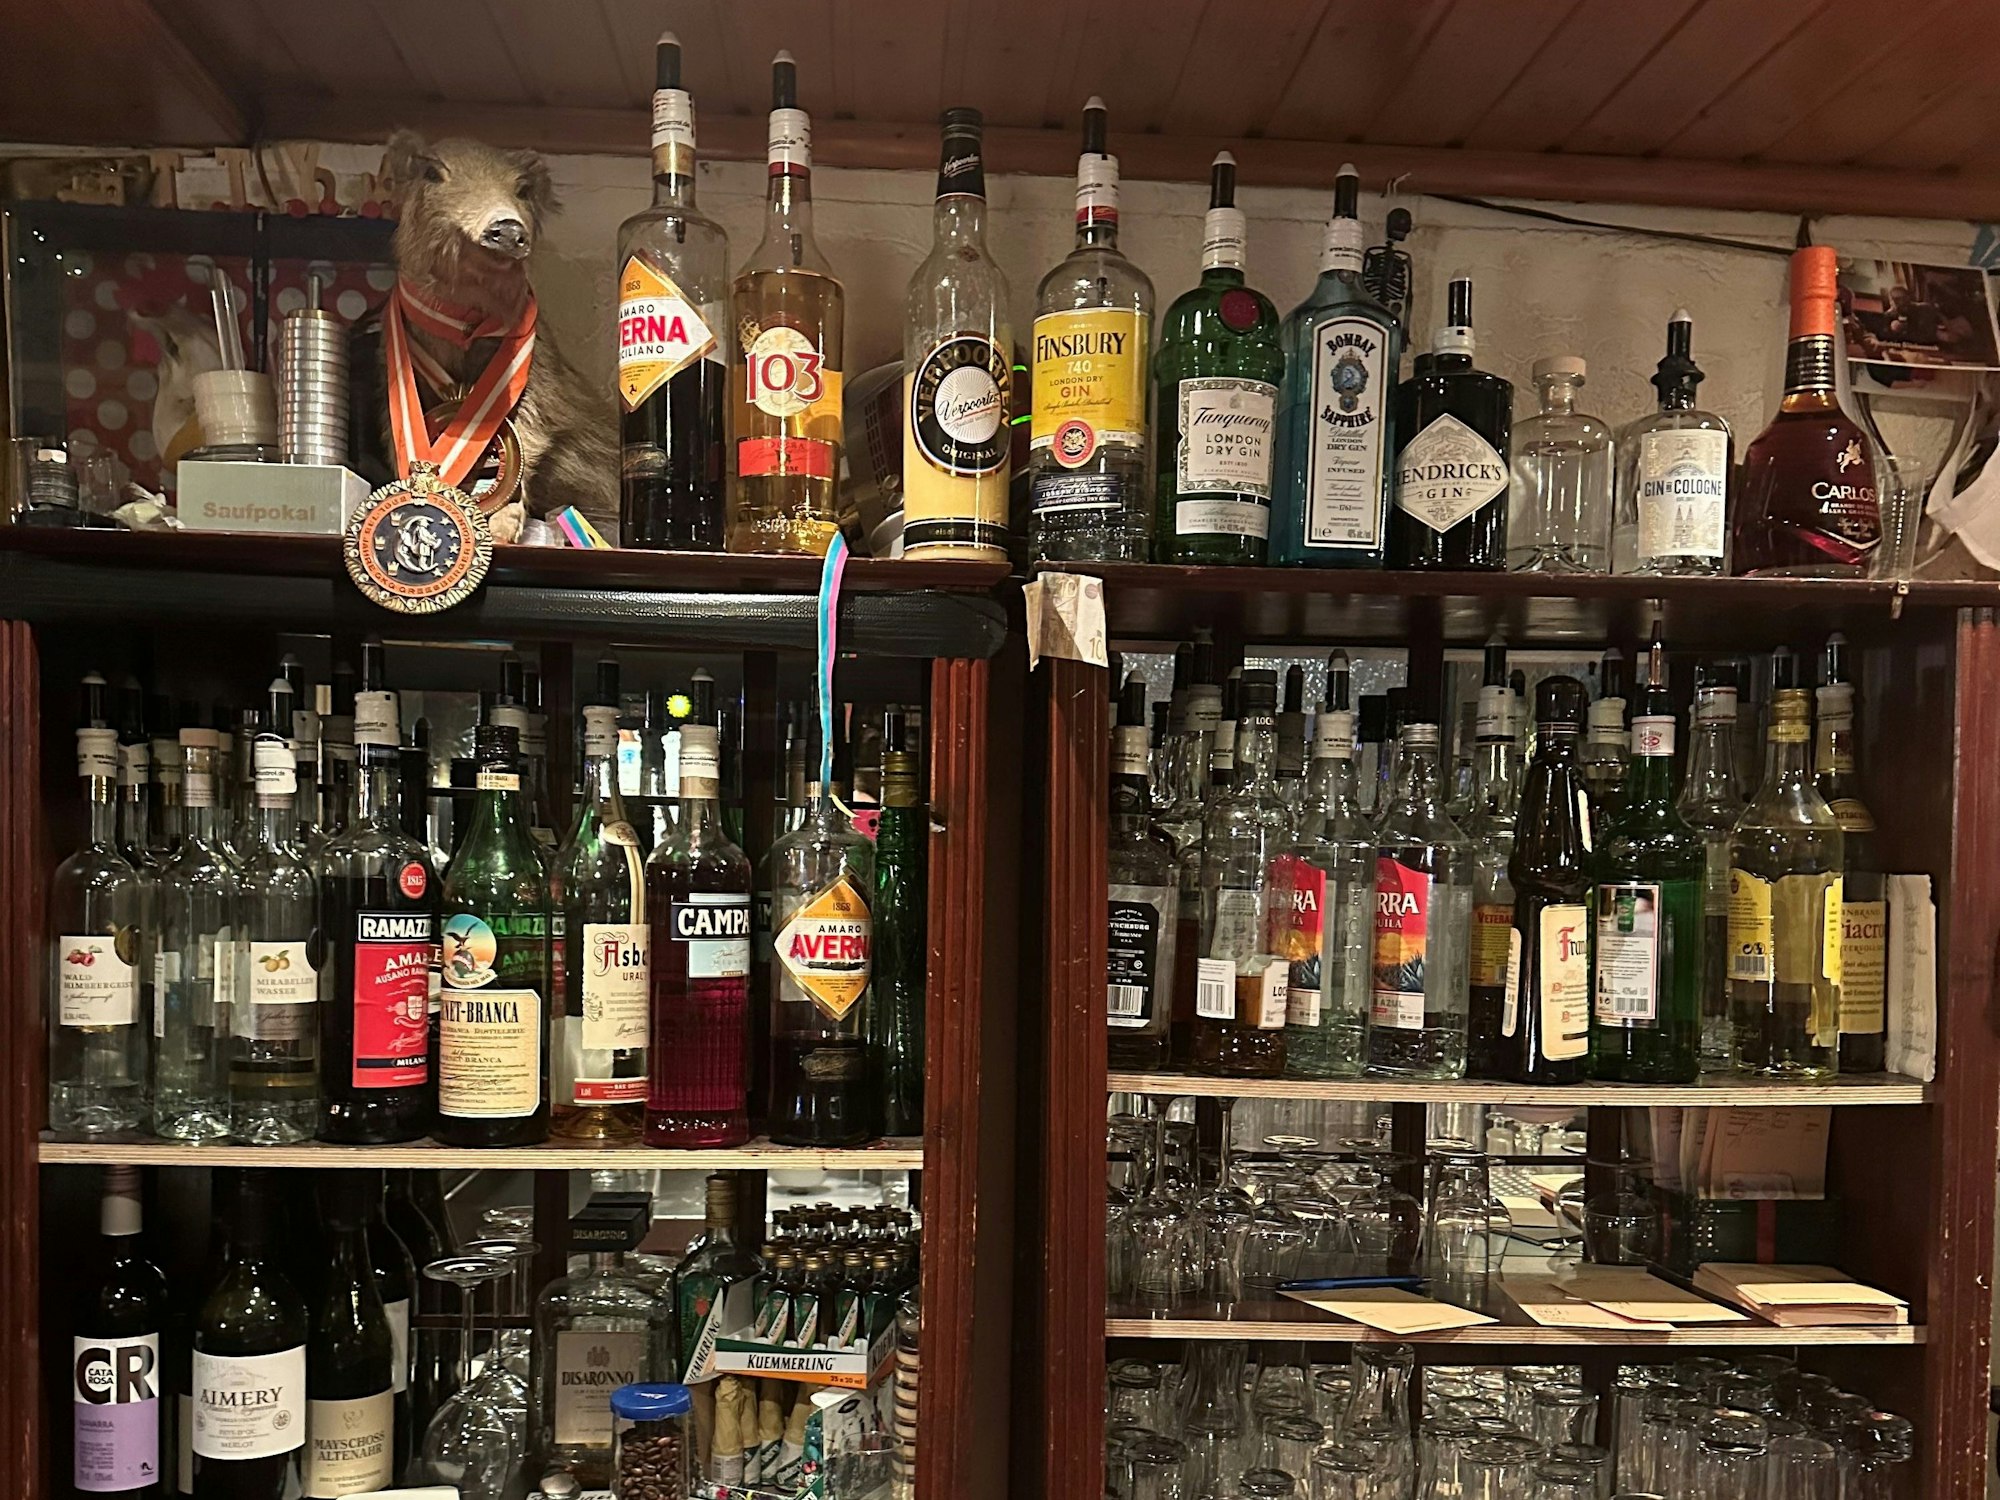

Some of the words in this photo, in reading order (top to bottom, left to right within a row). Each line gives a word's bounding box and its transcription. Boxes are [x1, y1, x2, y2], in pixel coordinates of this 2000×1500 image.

[620, 316, 689, 347] ERNA
[1036, 332, 1127, 364] FINSBURY
[1326, 333, 1376, 358] BOMBAY
[746, 351, 825, 404] 103
[918, 343, 1011, 429] VERPOORTEN
[1050, 377, 1083, 387] LONDON
[1086, 375, 1104, 383] DRY
[1060, 385, 1090, 398] GIN
[1193, 407, 1270, 433] Tanqueray
[1320, 405, 1377, 428] SAPPHIRE
[1206, 433, 1261, 446] LONDON
[1327, 443, 1346, 451] DRY
[1205, 445, 1233, 456] DRY
[1239, 446, 1261, 458] GIN
[1427, 487, 1463, 498] GIN
[1644, 480, 1664, 497] GIN
[1674, 479, 1722, 497] COLOGNE
[1811, 482, 1876, 502] CARLOS
[203, 502, 316, 524] Saufpokal
[406, 875, 423, 886] 1815
[677, 908, 750, 936] CAMPA
[818, 924, 862, 933] AMARO
[1107, 922, 1150, 931] YNCHBURG
[64, 981, 134, 989] HIMBEERGEIST
[375, 970, 410, 985] AUSANO
[257, 987, 297, 995] WASSER
[441, 1001, 519, 1024] NET-BRANCA
[573, 1229, 628, 1240] DISARONNO
[747, 1354, 834, 1371] KUEMMERLING
[76, 1344, 155, 1405] CR
[88, 1368, 114, 1377] CATA
[88, 1377, 114, 1385] ROSA
[562, 1371, 635, 1387] DISARONNO
[200, 1387, 283, 1406] AIMERY
[314, 1430, 385, 1450] MAYSCHOSS
[317, 1443, 383, 1461] ALTENAHR
